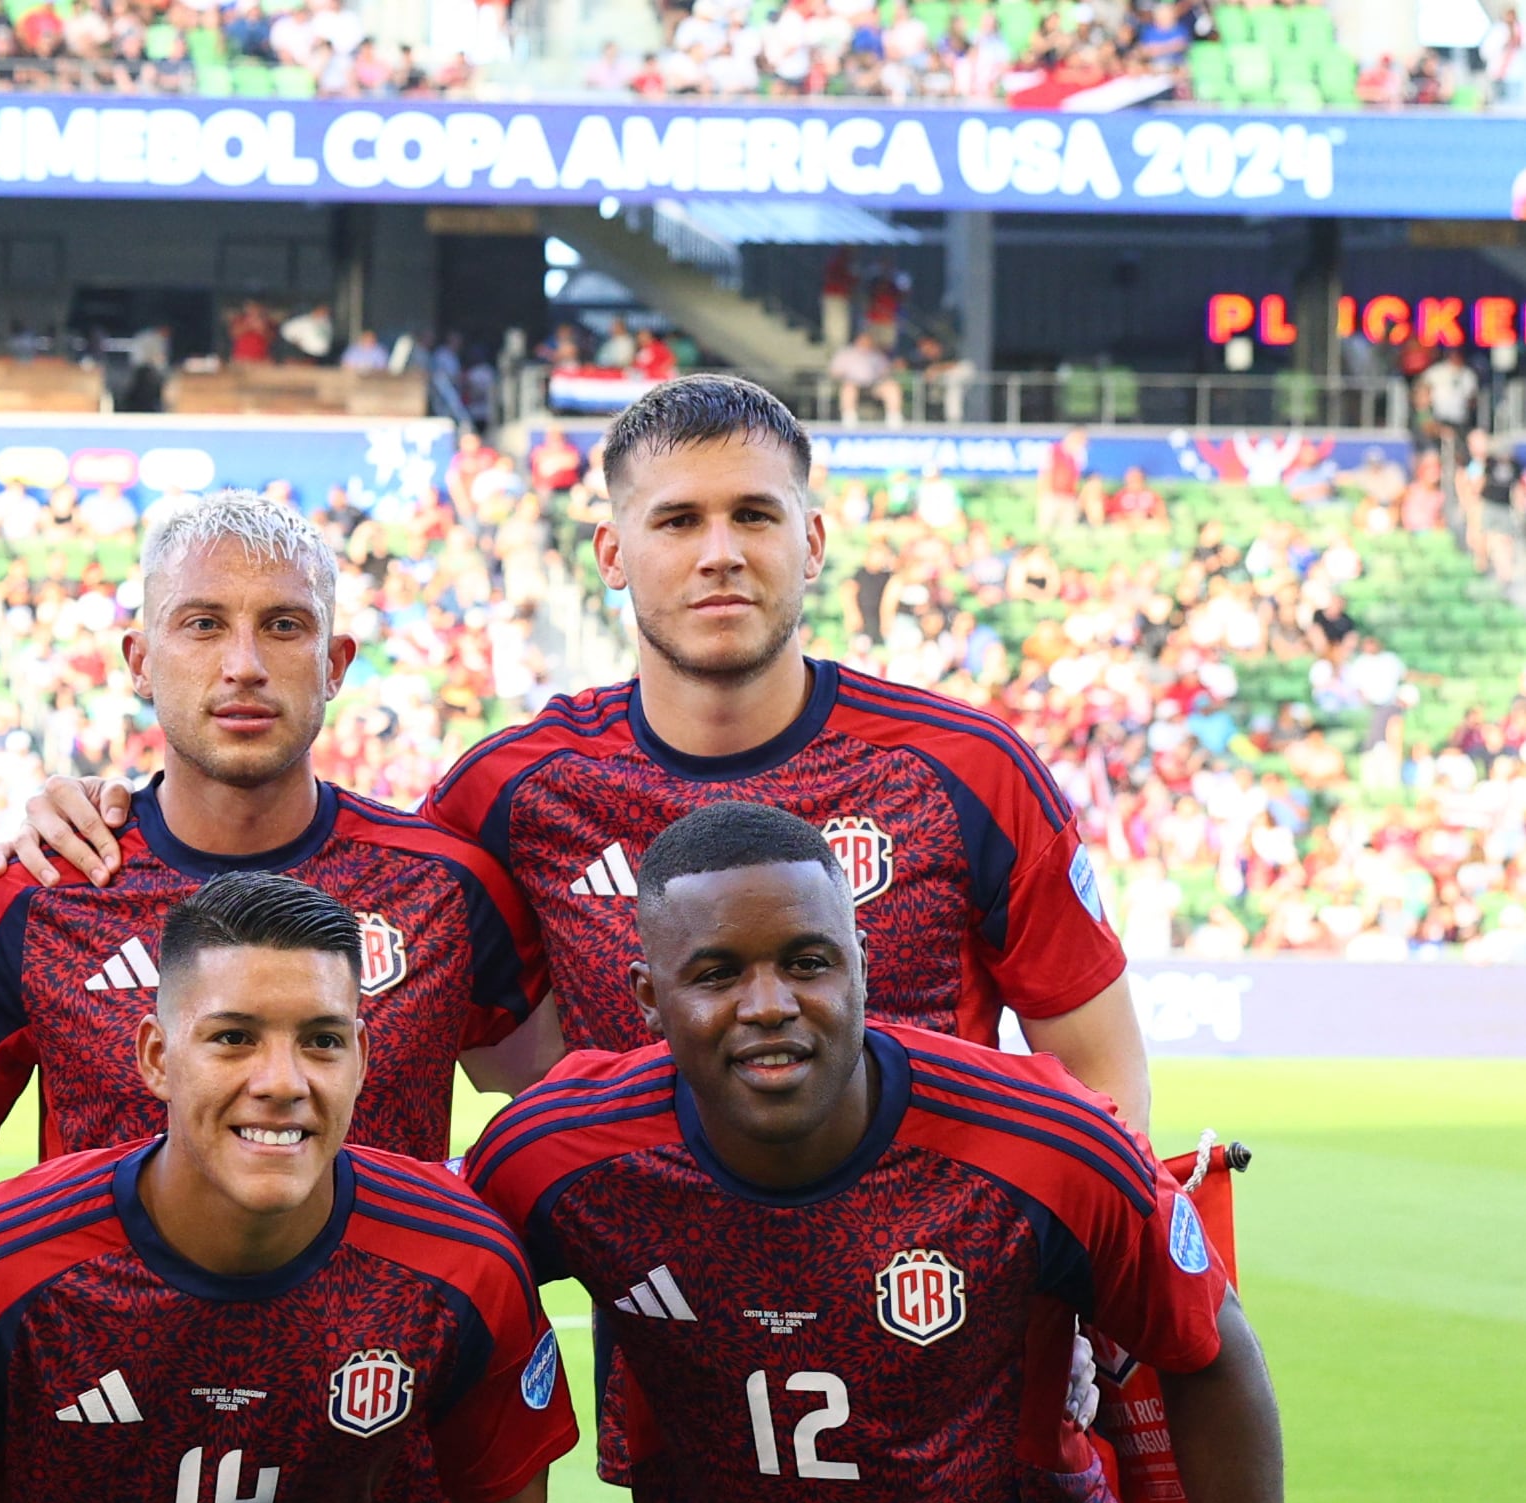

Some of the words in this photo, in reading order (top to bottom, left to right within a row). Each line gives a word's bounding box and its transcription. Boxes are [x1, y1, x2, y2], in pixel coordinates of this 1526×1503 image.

[322, 111, 558, 189] COPA
[559, 115, 945, 195] AMERICA
[957, 118, 1123, 200] USA
[1132, 122, 1334, 199] 2024
[1207, 294, 1526, 347] PLCKE
[361, 929, 388, 980] R
[897, 1269, 945, 1327] CR
[348, 1367, 394, 1421] CR
[1134, 1398, 1165, 1424] RIC
[746, 1370, 860, 1480] 12
